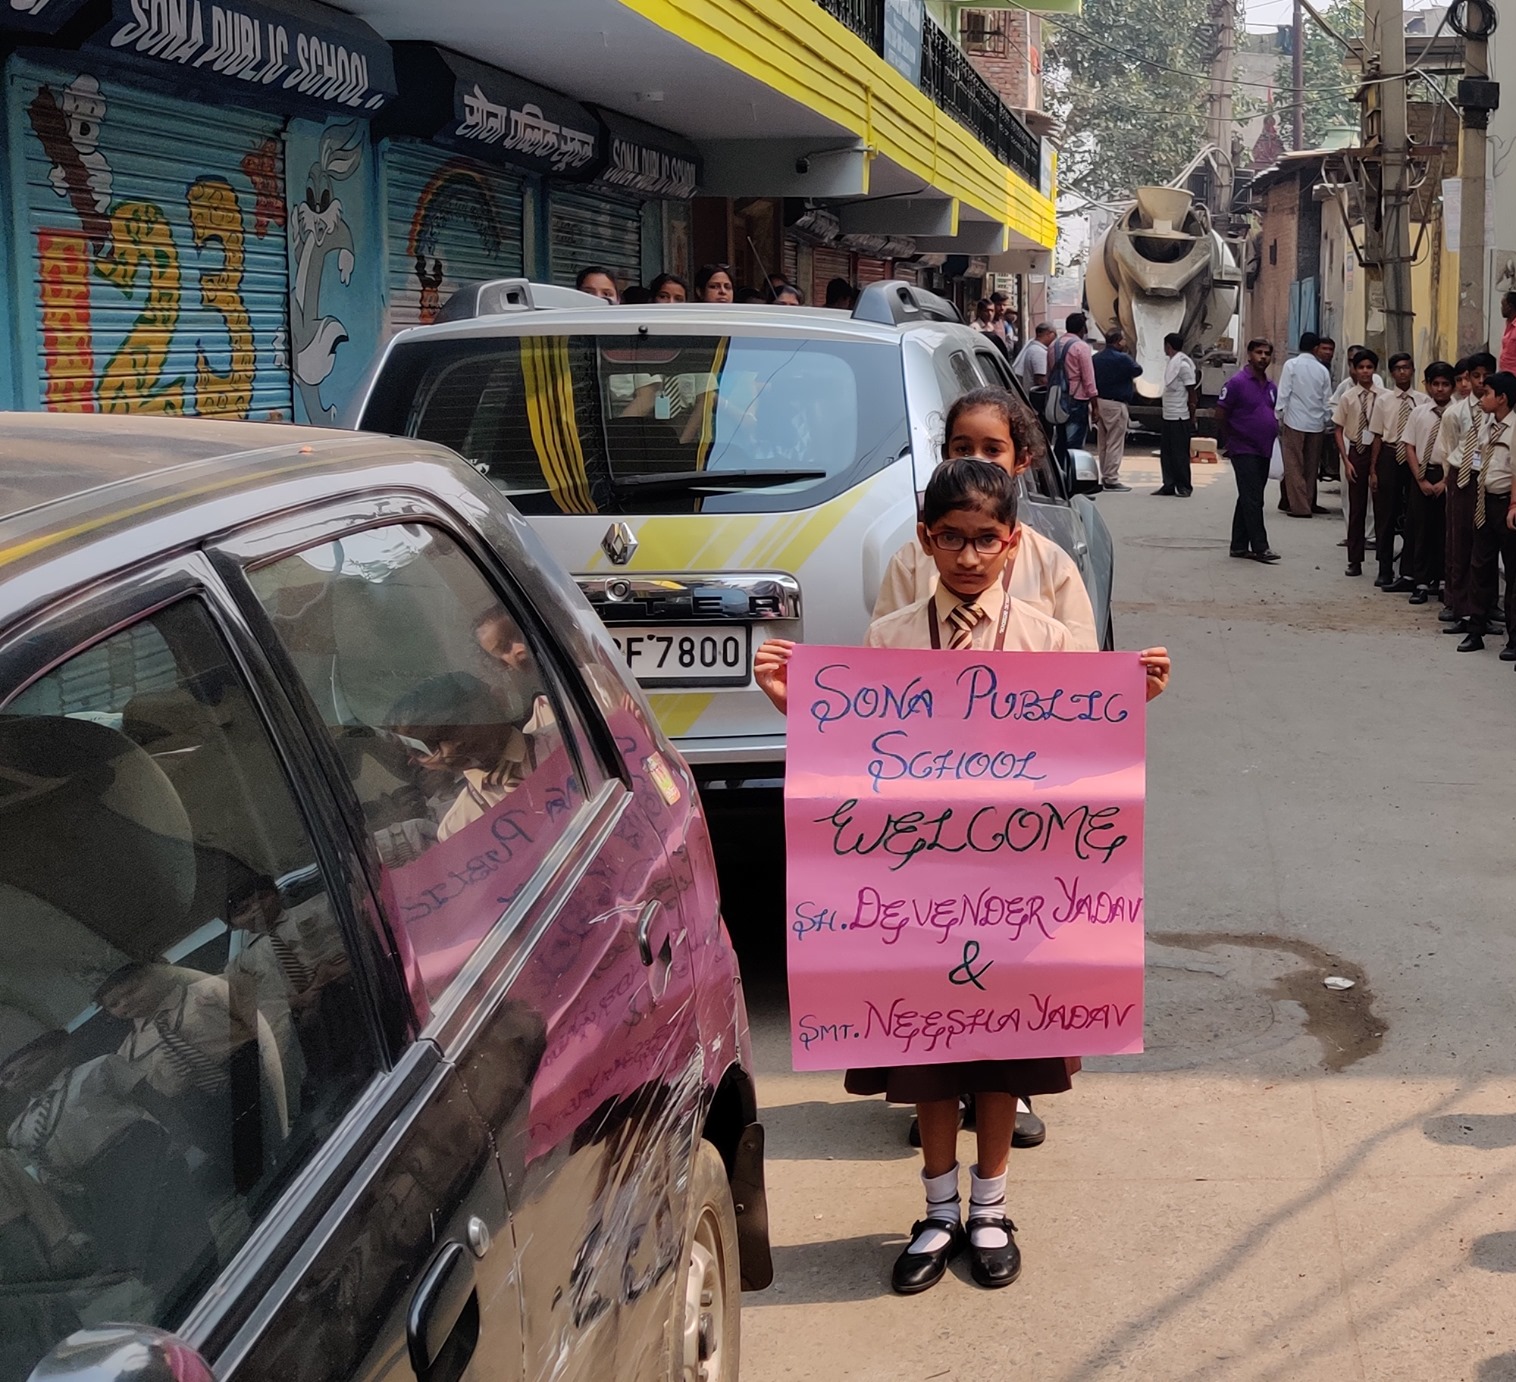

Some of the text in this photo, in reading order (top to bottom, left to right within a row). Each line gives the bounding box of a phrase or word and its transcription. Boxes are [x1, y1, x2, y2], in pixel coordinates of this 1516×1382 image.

[110, 0, 204, 64] SONA
[193, 5, 289, 85] PUBLIC
[455, 84, 507, 144] सोना
[503, 103, 560, 157] पब्लिक
[656, 636, 740, 669] 7800
[810, 664, 1128, 733] SONA PUBLIC
[867, 730, 1048, 794] SCHOOL
[813, 798, 1128, 871] WELCOME
[850, 886, 1056, 944] DEVENDER
[1052, 876, 1144, 925] YADAV
[948, 940, 994, 990] &
[864, 998, 1021, 1053] NEESHA
[1027, 993, 1136, 1032] YADAV
